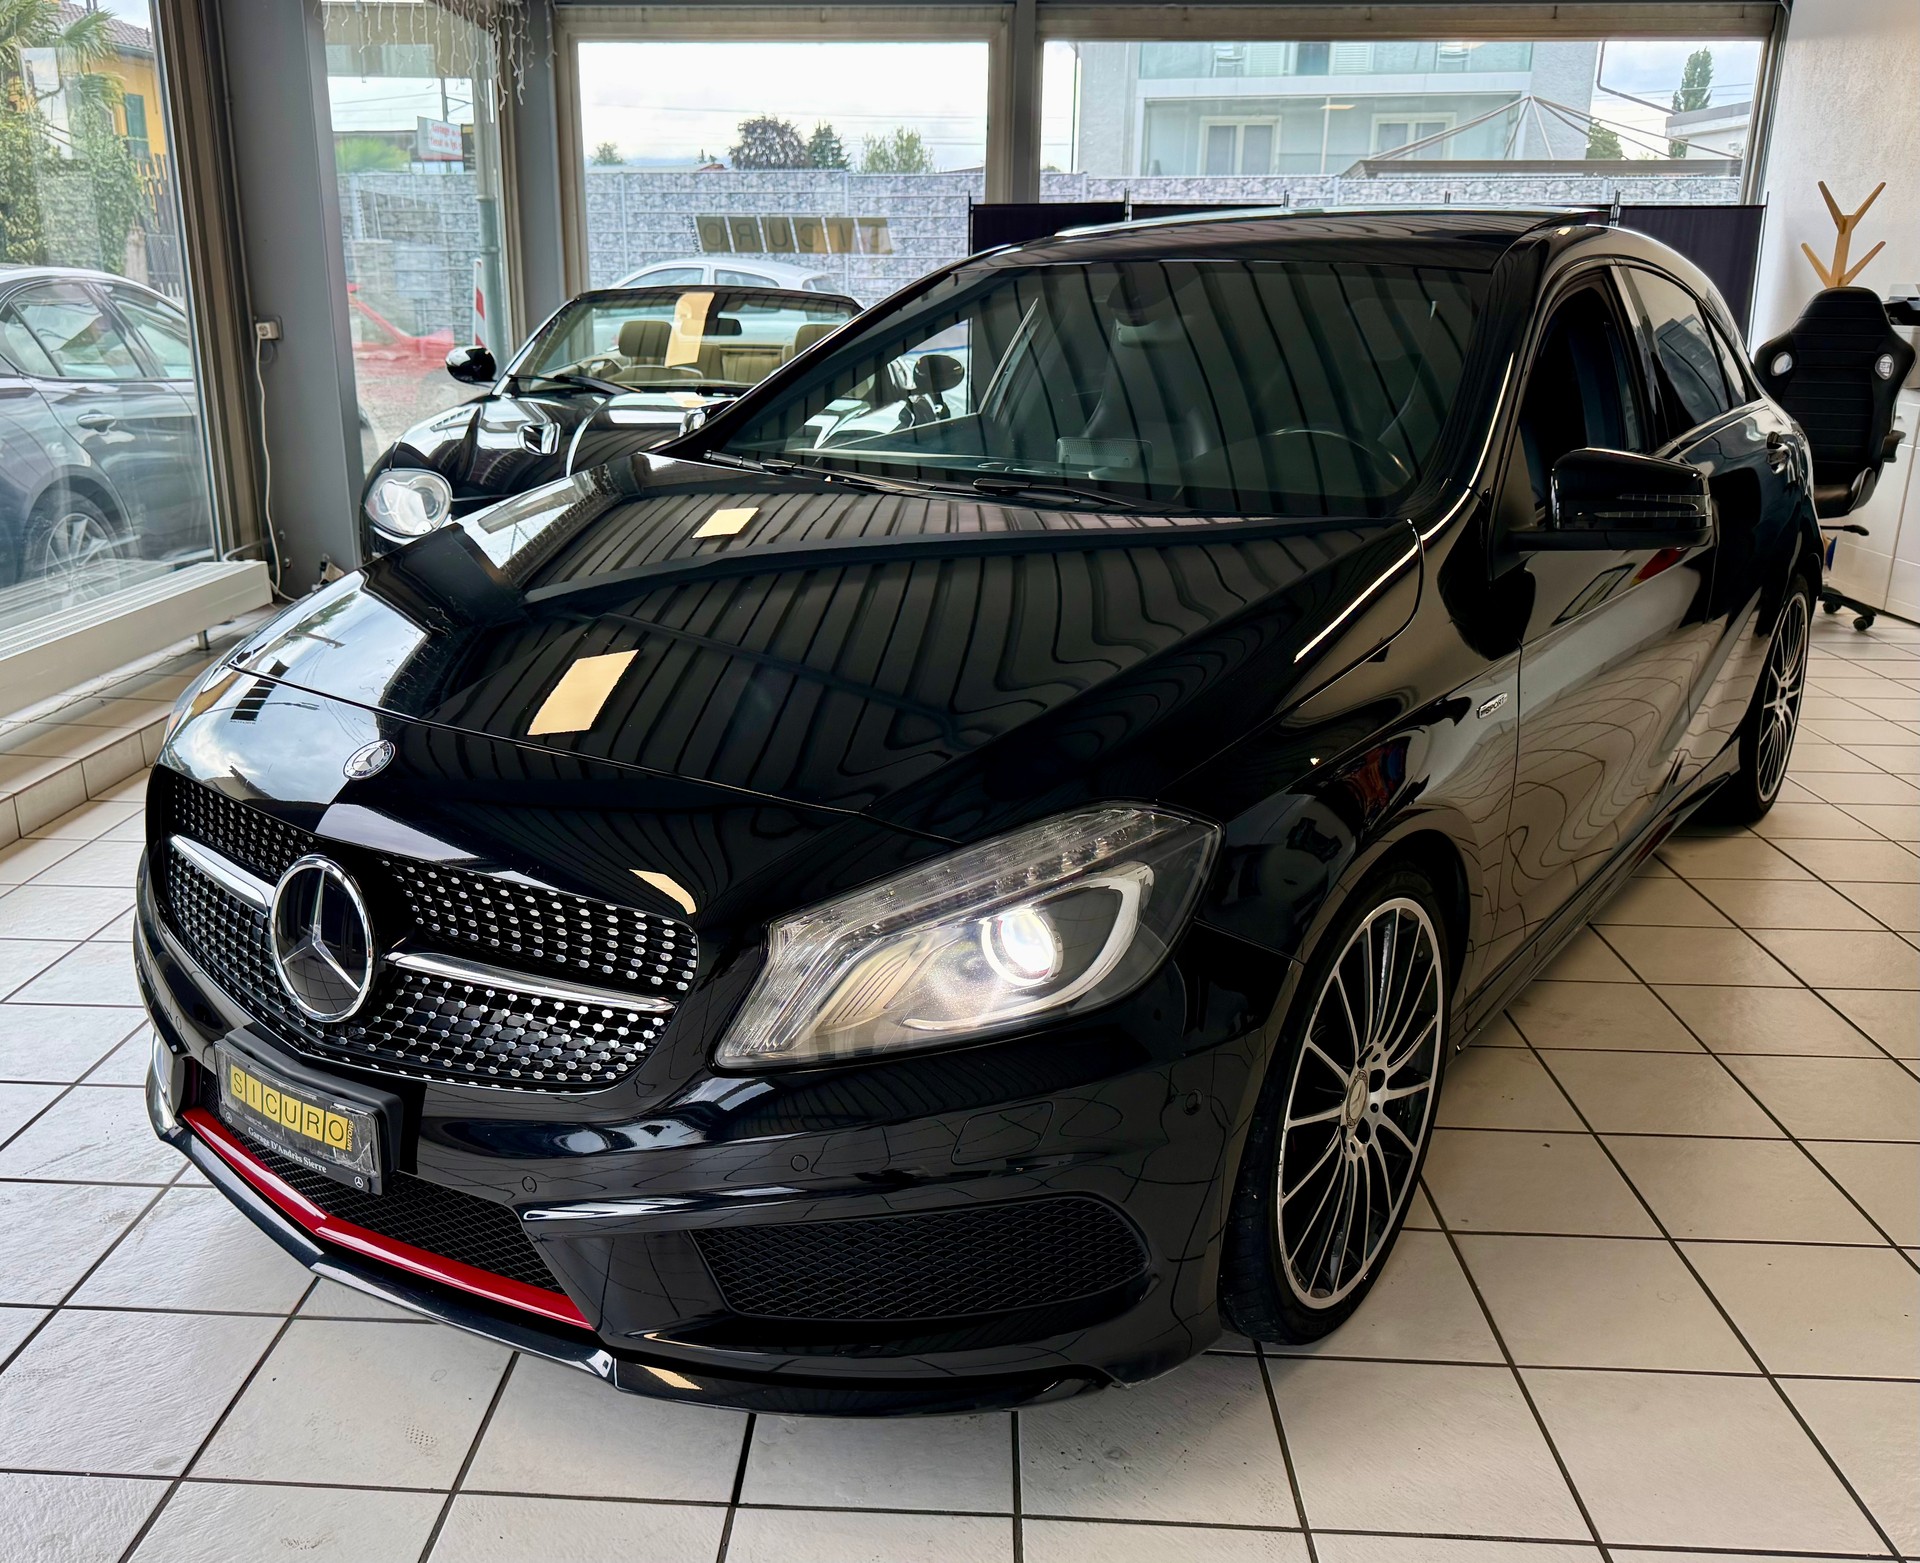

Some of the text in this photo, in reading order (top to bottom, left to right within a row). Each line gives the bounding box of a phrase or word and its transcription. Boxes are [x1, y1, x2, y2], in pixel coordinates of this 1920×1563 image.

[233, 1072, 344, 1142] SICURO
[247, 1126, 270, 1147] Garage
[303, 1156, 327, 1173] Sierre
[346, 1119, 354, 1152] MOTORS
